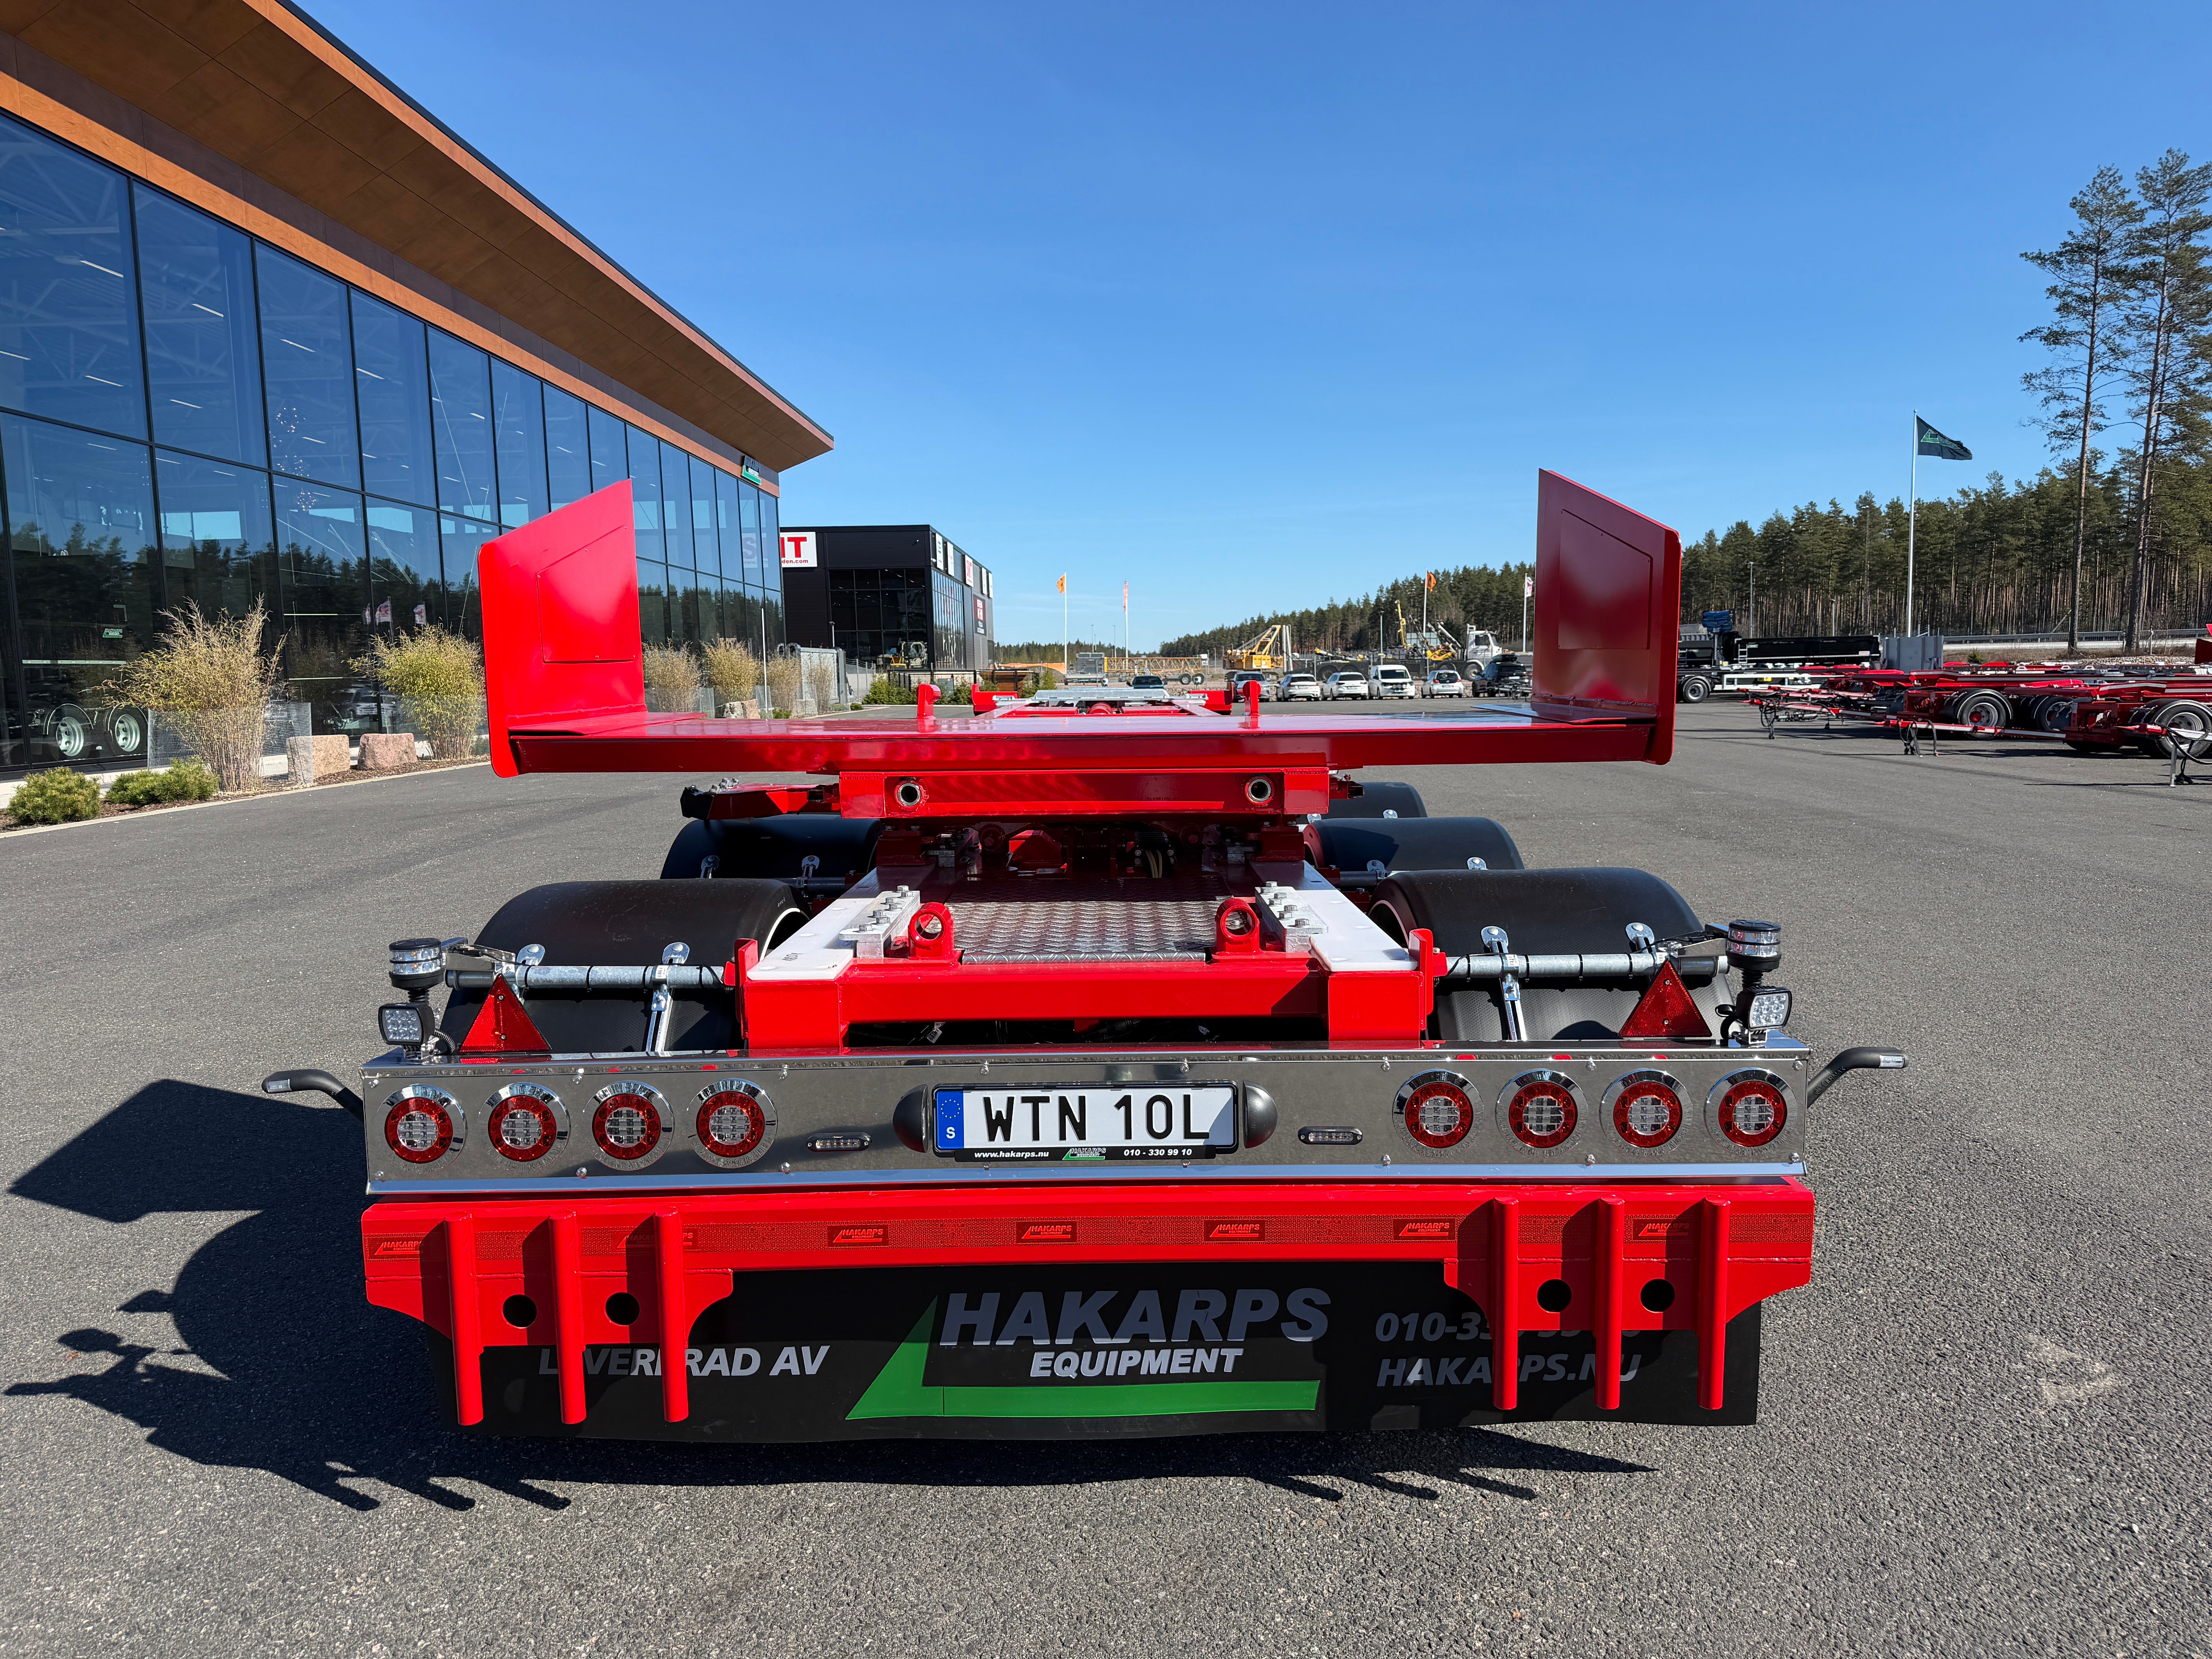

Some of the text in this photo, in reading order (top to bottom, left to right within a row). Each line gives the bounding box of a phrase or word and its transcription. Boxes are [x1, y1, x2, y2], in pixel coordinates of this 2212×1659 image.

[946, 1127, 955, 1139] S
[982, 1096, 1086, 1142] WTN
[1114, 1094, 1210, 1140] 10L
[974, 1151, 1049, 1159] www.hakarps.nu
[940, 1288, 1331, 1346] HAKARPS
[539, 1345, 831, 1376] LVERRAD AV
[1030, 1348, 1244, 1379] EQUIPMENT
